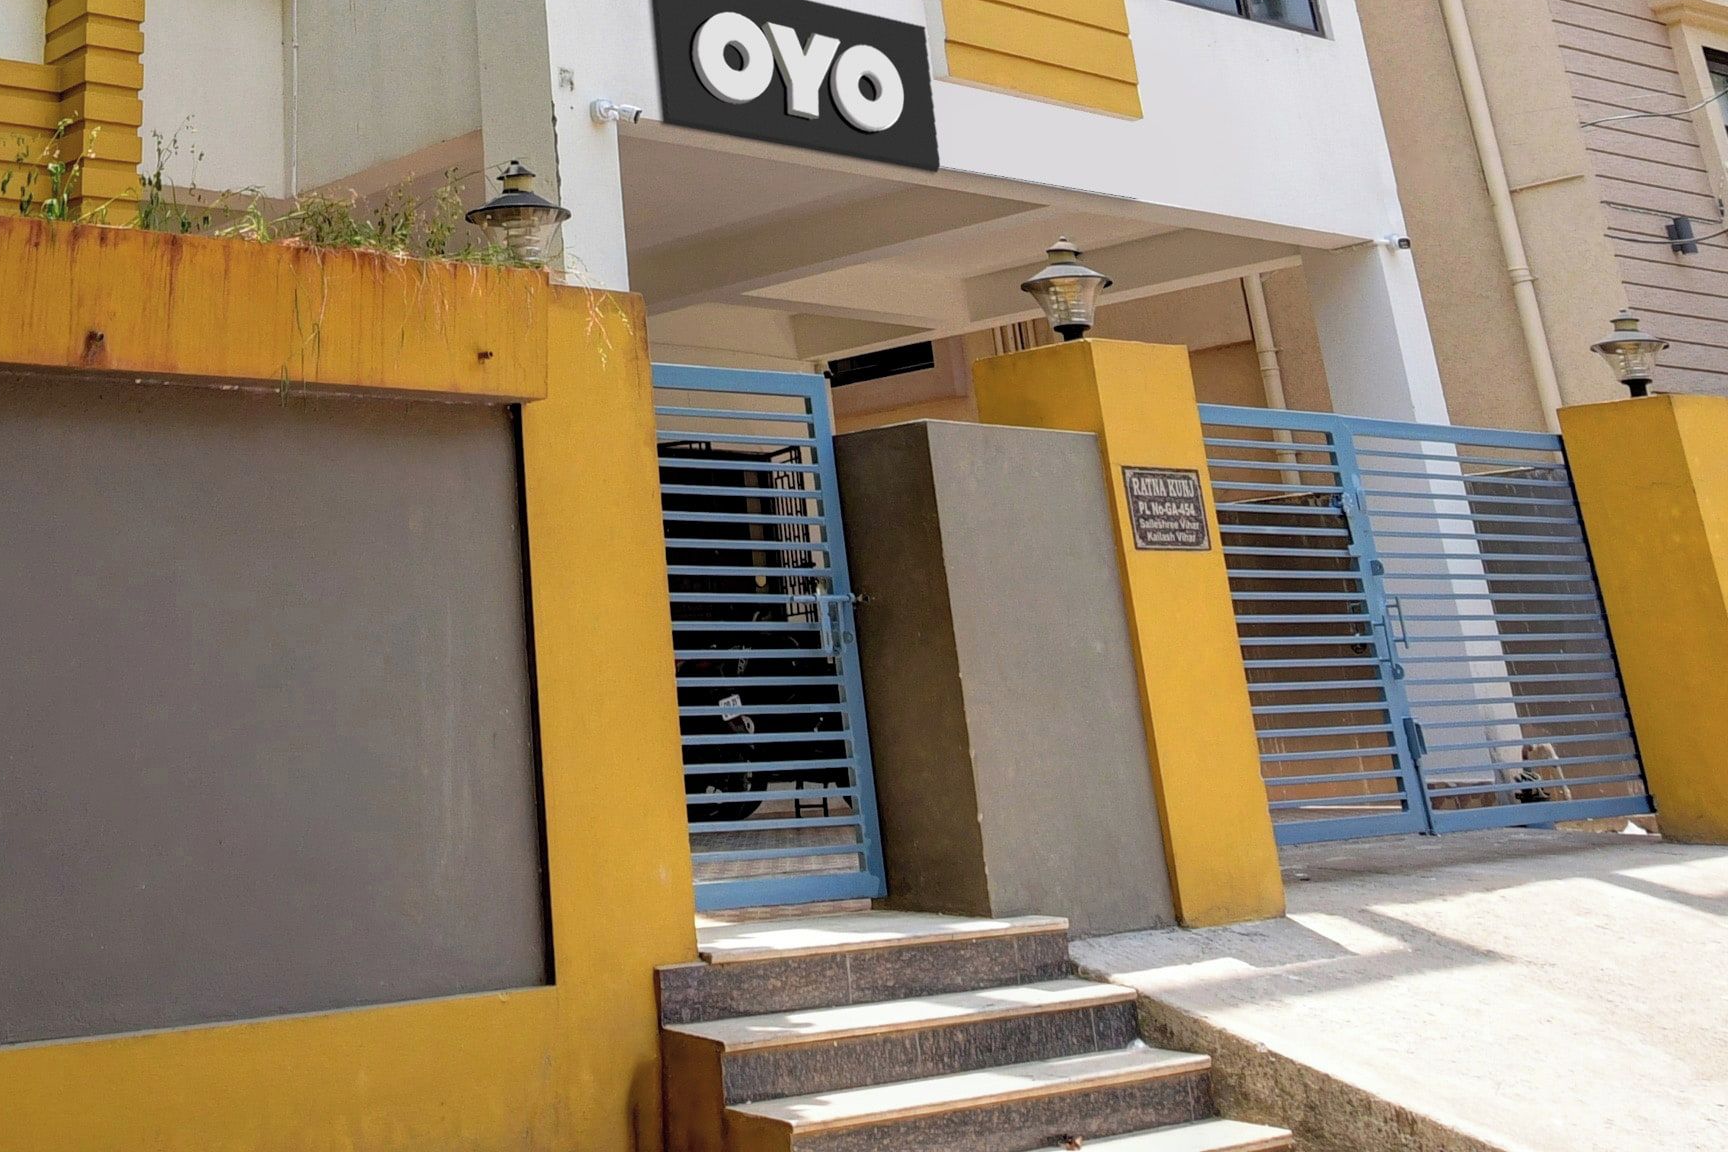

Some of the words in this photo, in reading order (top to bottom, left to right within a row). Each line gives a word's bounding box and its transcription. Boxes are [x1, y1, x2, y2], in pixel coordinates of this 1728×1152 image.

[691, 12, 904, 133] OYO
[1132, 478, 1167, 496] RATNA
[1167, 480, 1195, 497] KUNJ
[1139, 502, 1151, 515] PL
